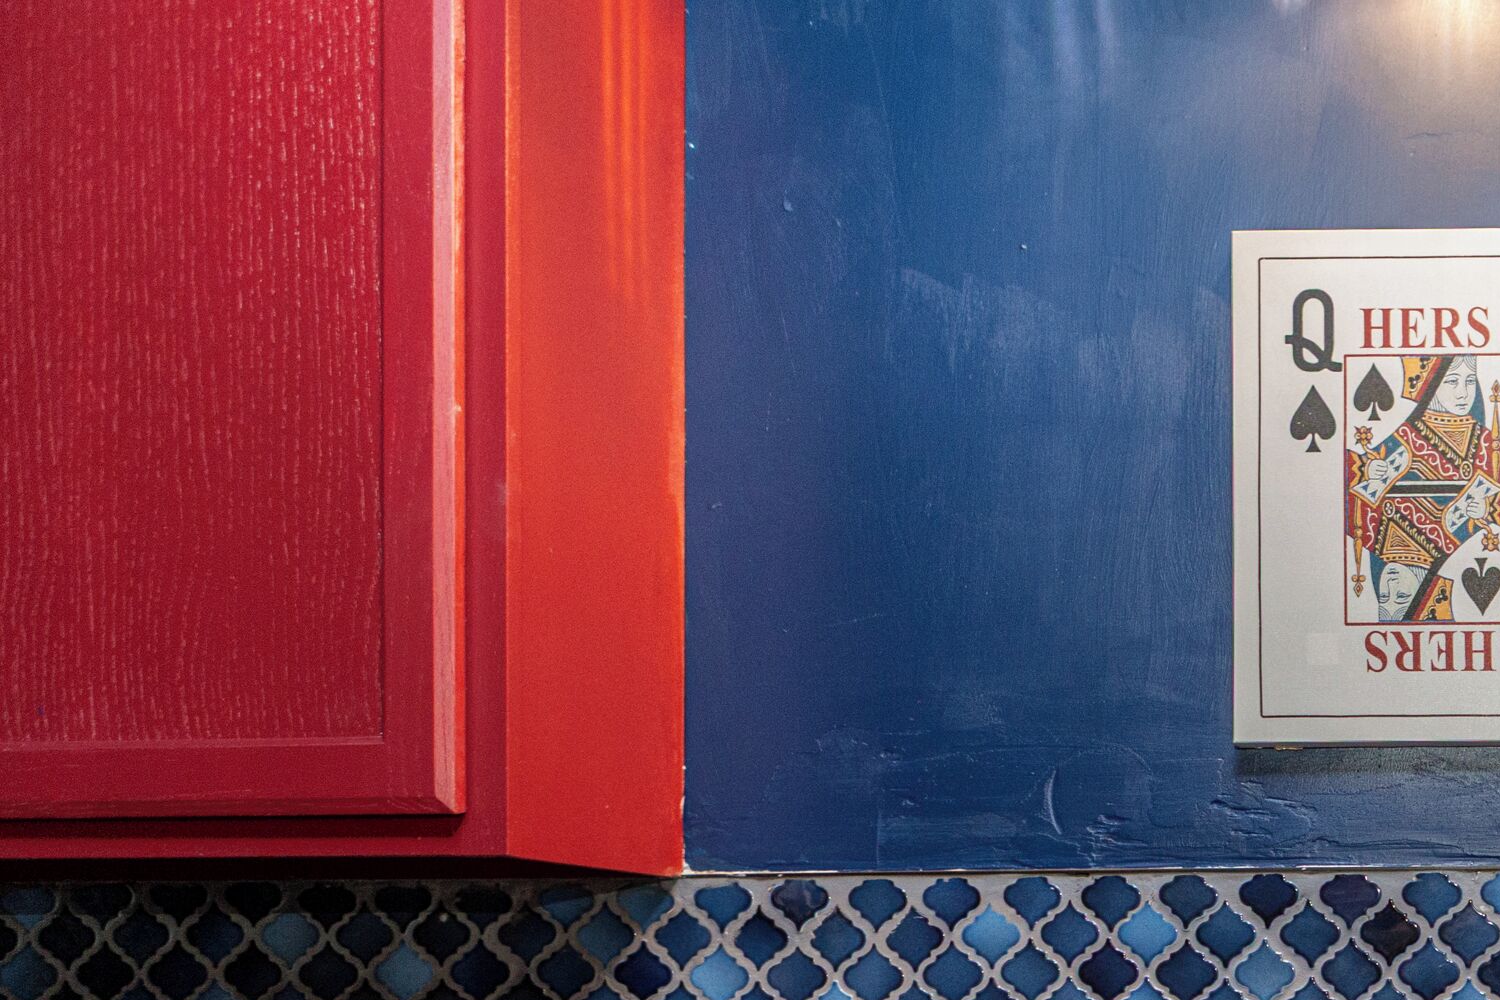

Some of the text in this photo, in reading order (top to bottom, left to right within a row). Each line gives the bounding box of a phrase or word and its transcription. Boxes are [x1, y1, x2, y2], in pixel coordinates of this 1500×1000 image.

[1284, 288, 1343, 372] Q
[1359, 306, 1490, 349] HERS
[1364, 630, 1497, 673] HERS
